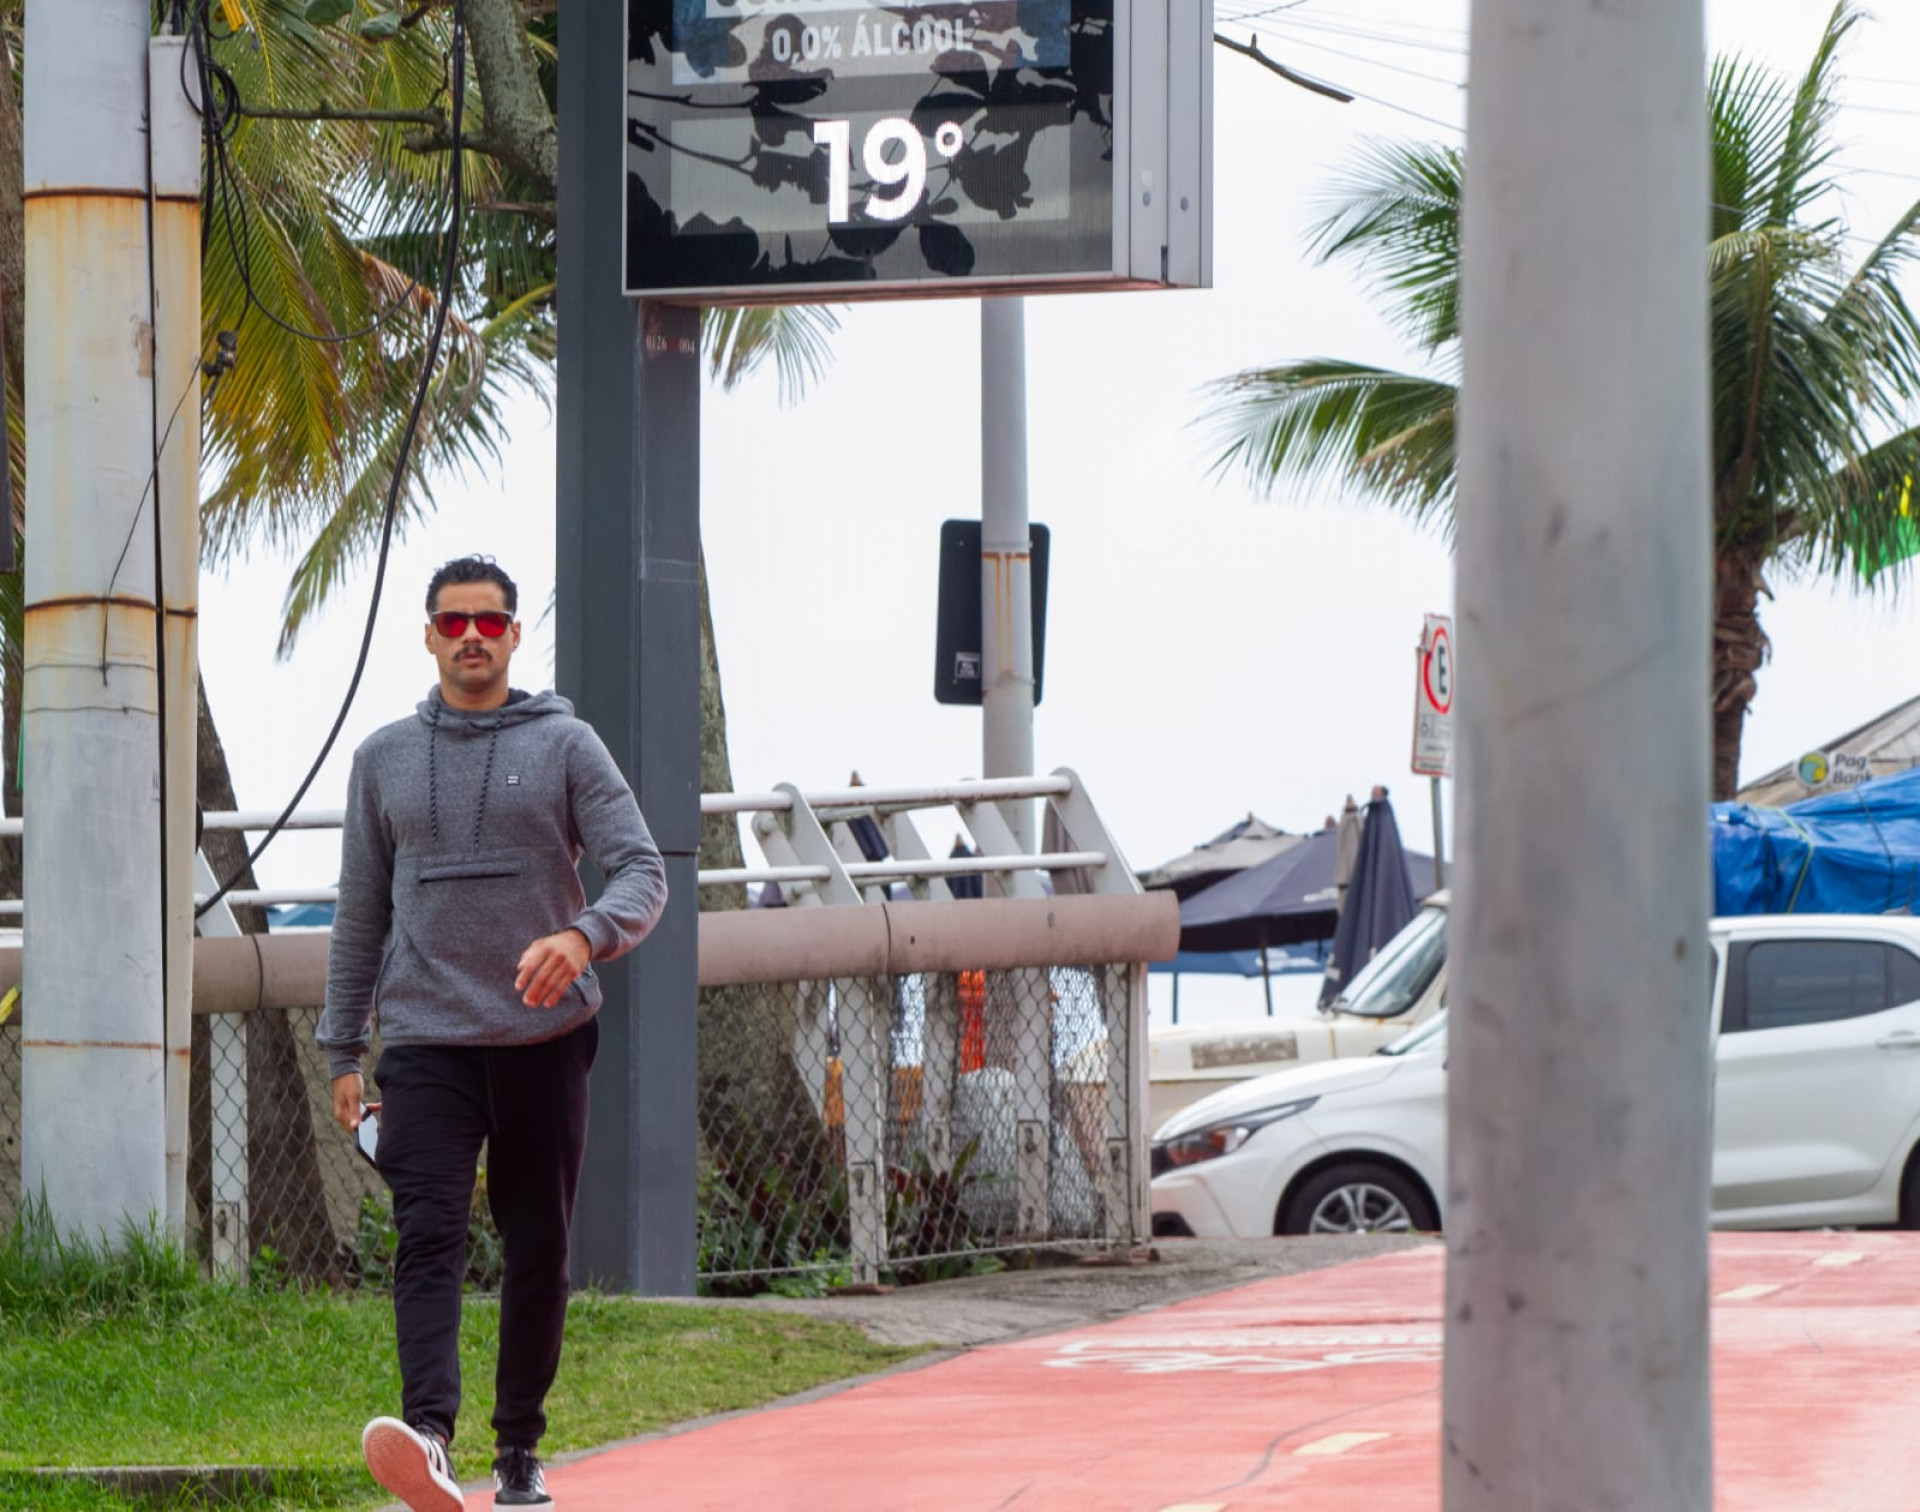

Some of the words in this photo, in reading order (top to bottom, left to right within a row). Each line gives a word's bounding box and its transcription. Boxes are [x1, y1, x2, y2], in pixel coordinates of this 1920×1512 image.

[772, 24, 842, 62] 0,0%
[851, 14, 973, 57] ÁLCOOL
[1438, 645, 1447, 695] E
[1833, 770, 1872, 785] Bank
[1835, 753, 1867, 771] Pag
